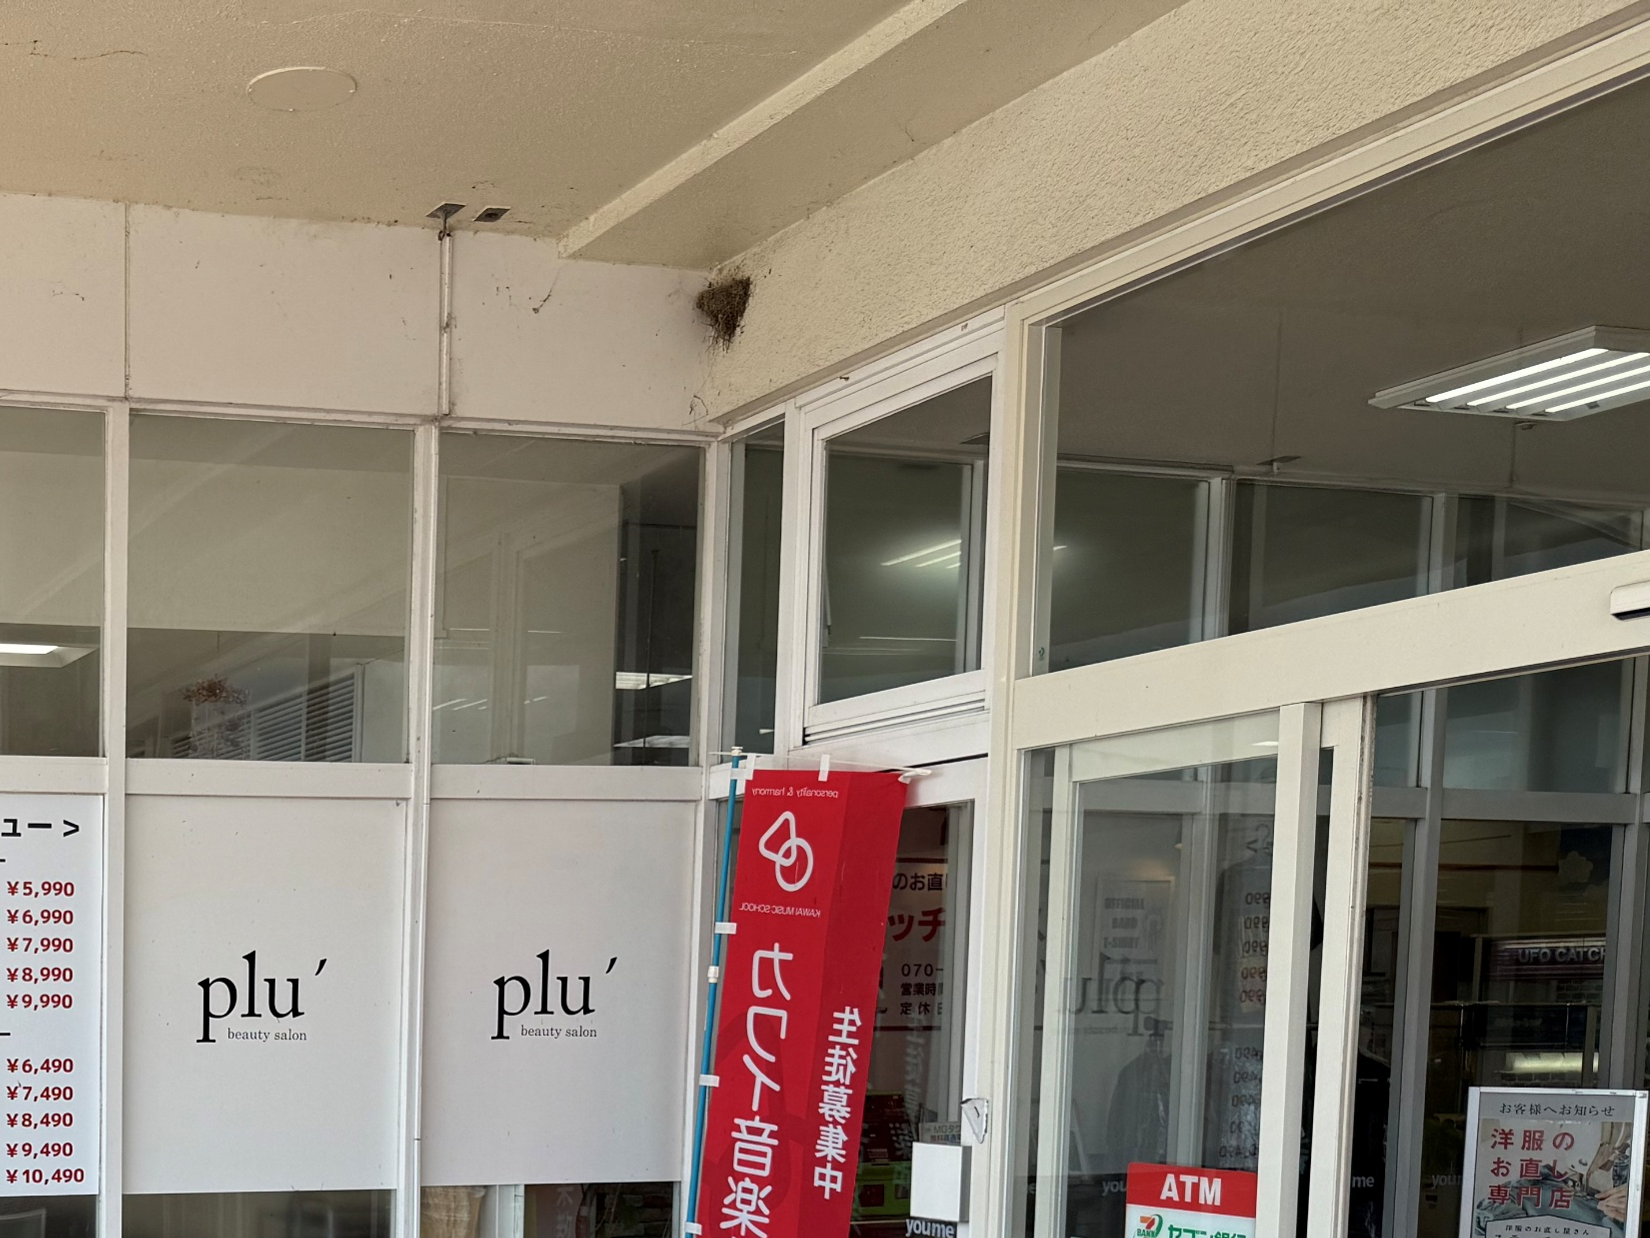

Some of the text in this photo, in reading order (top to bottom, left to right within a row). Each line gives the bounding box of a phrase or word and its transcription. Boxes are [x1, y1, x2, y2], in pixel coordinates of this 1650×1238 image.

[892, 872, 947, 891] のお直
[7, 882, 74, 898] ¥5,990
[7, 910, 73, 926] ¥6,990
[7, 938, 73, 954] ¥7,990
[1518, 948, 1551, 963] UFO
[7, 967, 72, 984] ¥8,990
[7, 994, 72, 1010] ¥9,990
[227, 1028, 307, 1043] beauty salon
[520, 1025, 597, 1039] beauty salon
[7, 1059, 73, 1074] ¥6,490
[7, 1086, 73, 1101] ¥7,490
[1500, 1102, 1615, 1117] お客様へお知らせ
[7, 1113, 72, 1129] ¥8,490
[1491, 1128, 1575, 1151] 洋服の
[7, 1143, 72, 1159] ¥9,490
[1490, 1157, 1569, 1180] お直し
[7, 1169, 84, 1185] ¥10,490
[1160, 1173, 1222, 1206] ATM
[1487, 1185, 1574, 1209] 専門店
[905, 1218, 955, 1238] youme
